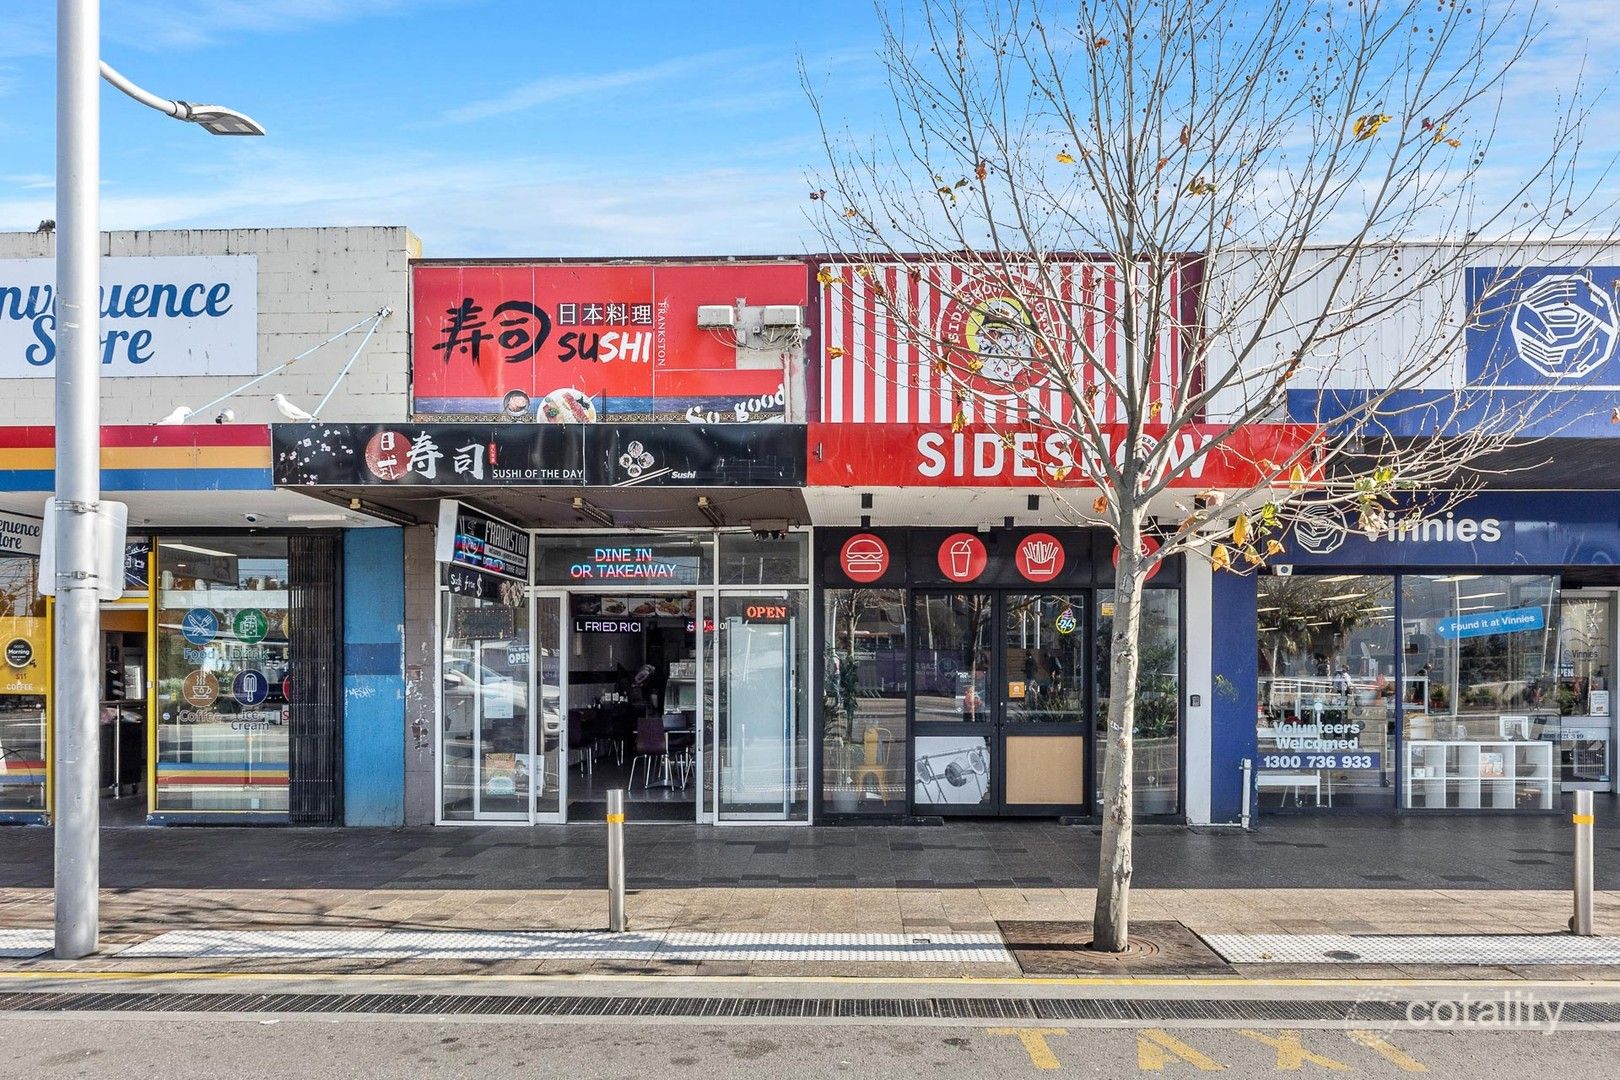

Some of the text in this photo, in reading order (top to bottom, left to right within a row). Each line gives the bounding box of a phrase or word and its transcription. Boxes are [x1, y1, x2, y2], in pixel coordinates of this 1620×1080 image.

[0, 283, 233, 320] nvience
[559, 303, 652, 326] 日本料理
[432, 298, 551, 367] 寿司
[657, 301, 666, 366] FRANKSTON
[26, 315, 155, 366] Sre
[558, 331, 652, 363] SUSHI
[406, 430, 485, 480] 寿司
[493, 470, 584, 478] SUSHI OF THE DAY
[671, 471, 697, 479] Sushi
[1361, 511, 1501, 542] innies
[484, 520, 529, 557] FRANKSTON
[595, 548, 652, 562] DINE IN
[570, 564, 677, 578] OR TAKEAWAY
[746, 606, 787, 619] OPEN
[585, 621, 618, 632] FRIED
[1451, 614, 1535, 632] Found it at Vinnies
[183, 647, 216, 660] Food
[231, 720, 269, 731] Cream
[1273, 722, 1361, 734] Volunteers
[1275, 737, 1359, 749] Welcomed
[1263, 755, 1372, 769] 1300 736 933
